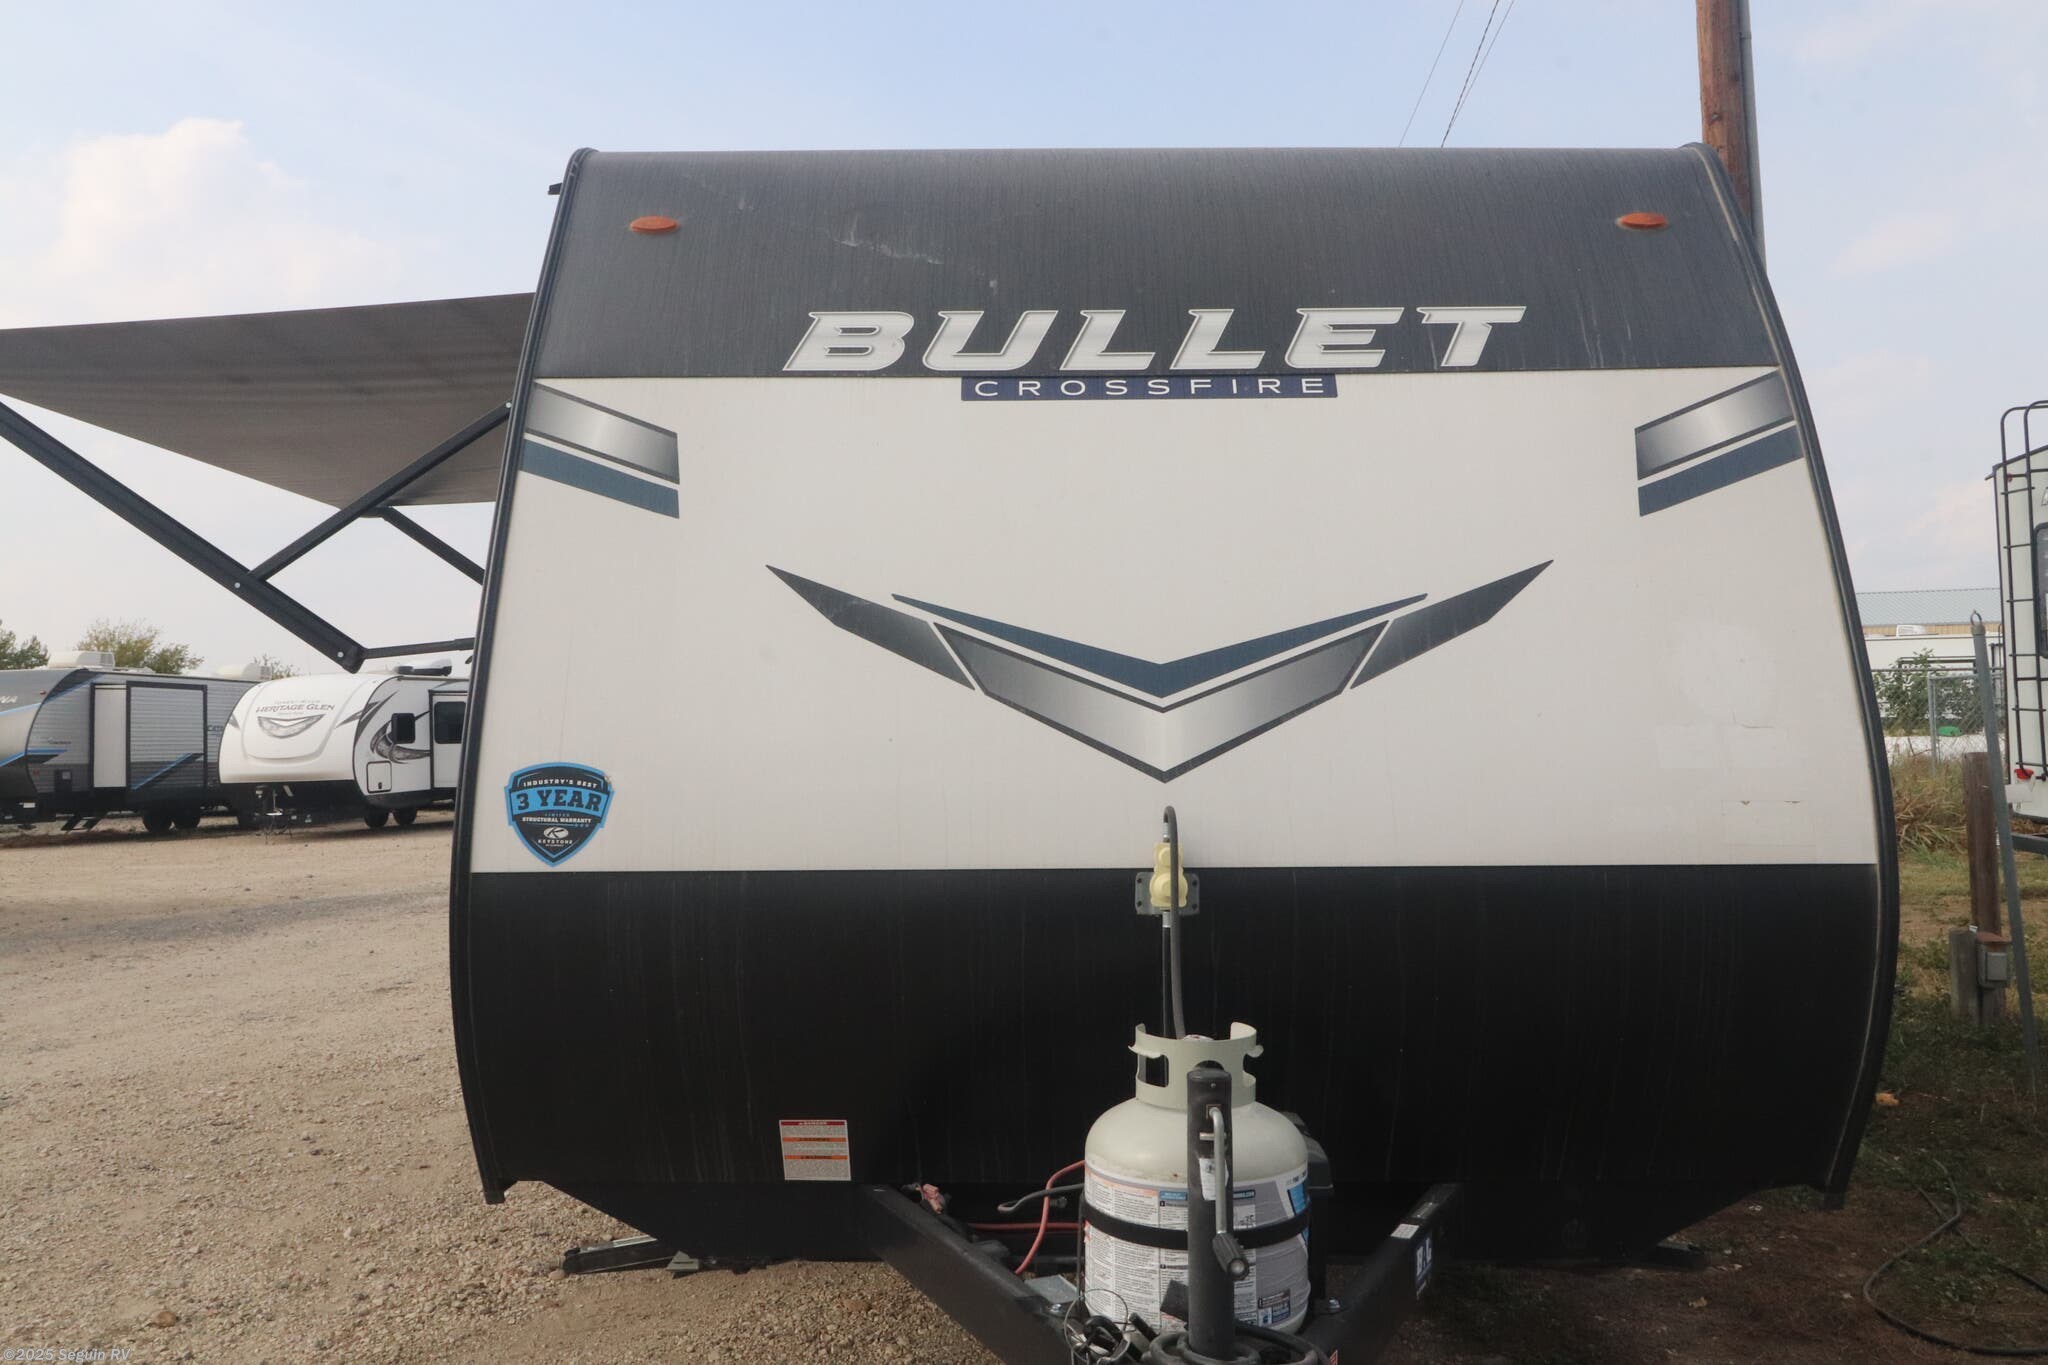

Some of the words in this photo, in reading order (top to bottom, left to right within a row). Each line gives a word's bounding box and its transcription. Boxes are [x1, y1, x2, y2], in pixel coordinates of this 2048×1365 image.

[783, 306, 1527, 372] BULLET
[974, 378, 1325, 397] CROSSFIRE
[256, 704, 304, 713] HERITAGE
[306, 703, 335, 711] GLEN
[523, 778, 574, 788] INDUSTRY'S
[577, 779, 598, 788] BEST
[516, 793, 530, 811] 3
[536, 790, 602, 811] YEAR
